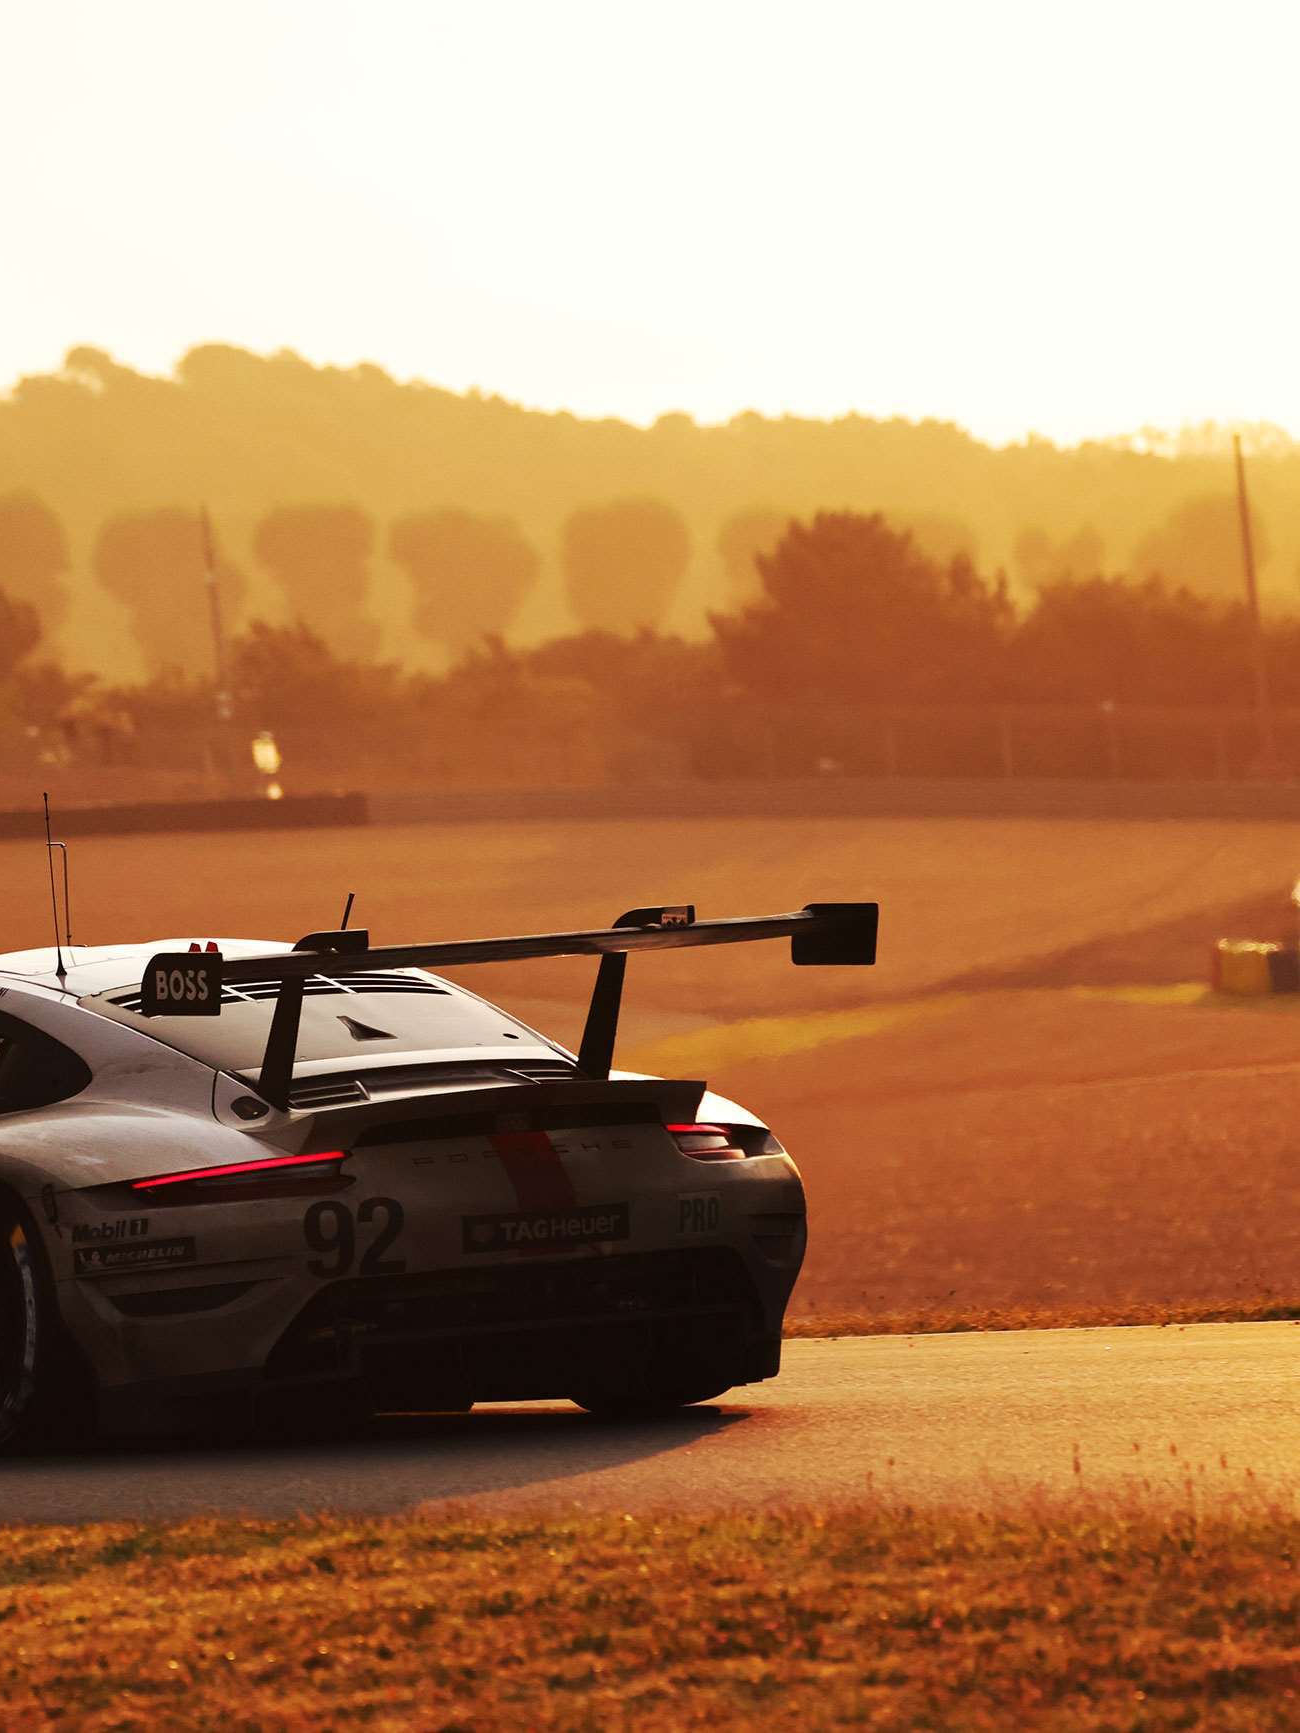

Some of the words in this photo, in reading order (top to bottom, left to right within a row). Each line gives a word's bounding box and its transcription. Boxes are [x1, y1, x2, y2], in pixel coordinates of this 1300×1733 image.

[155, 969, 210, 1001] BOSS
[72, 1219, 126, 1242] Mobil
[679, 1197, 719, 1233] PRO
[303, 1197, 406, 1279] 92
[105, 1245, 187, 1265] MICHELIN
